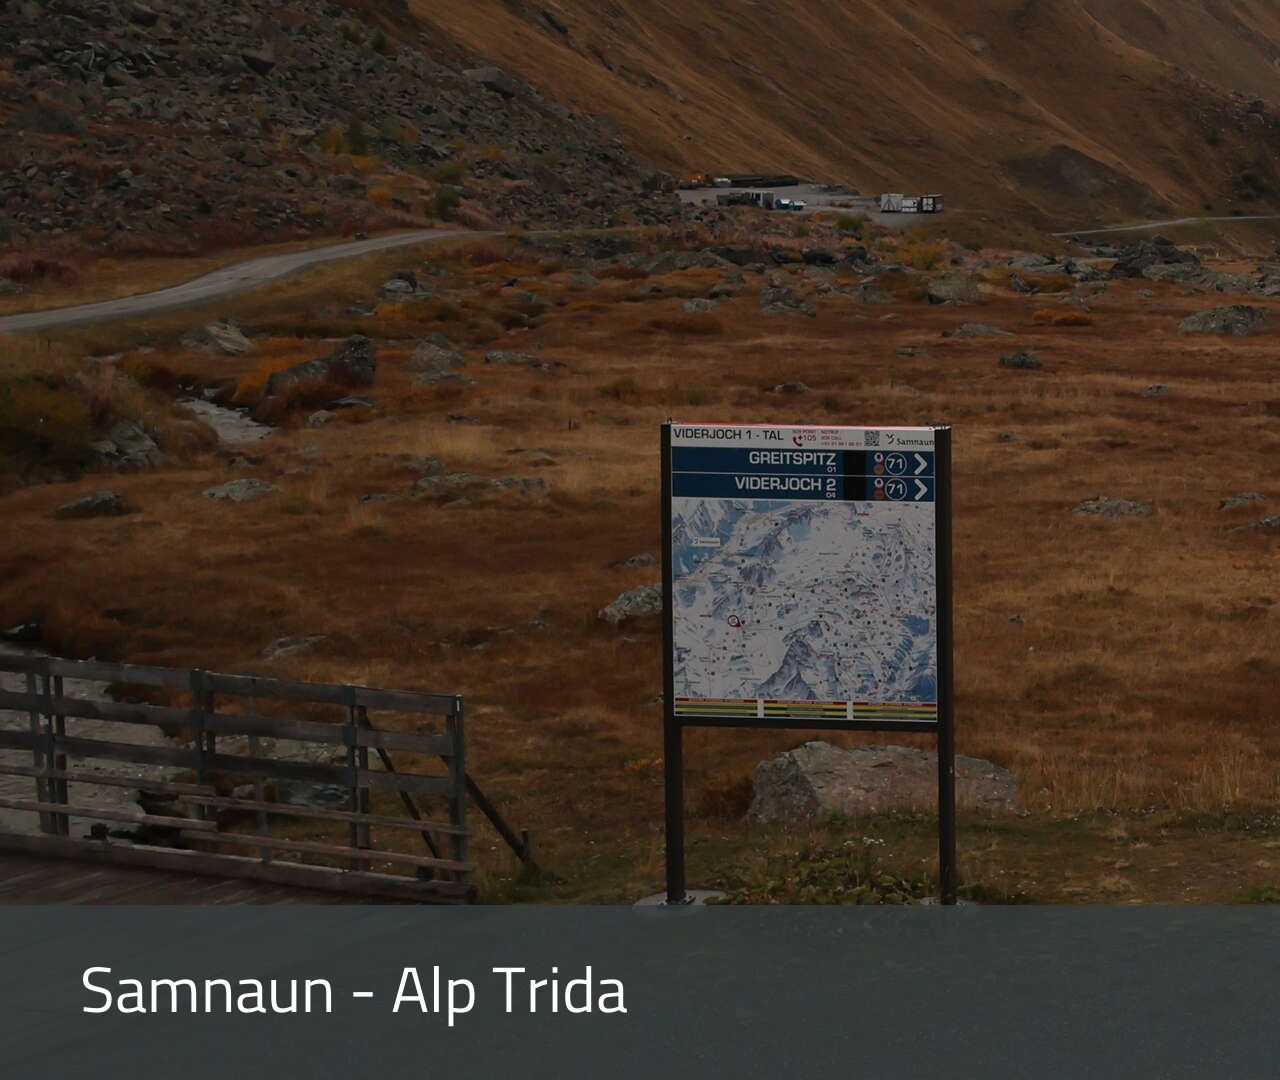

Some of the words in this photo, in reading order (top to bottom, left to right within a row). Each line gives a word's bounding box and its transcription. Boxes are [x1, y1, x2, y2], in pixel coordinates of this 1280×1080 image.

[673, 428, 742, 440] VIDERJOCH
[745, 430, 752, 440] 1
[763, 430, 784, 441] TAL
[896, 438, 935, 446] Samnaun
[749, 451, 837, 466] GREITSPITZ
[887, 458, 903, 469] 71
[735, 476, 822, 491] VIDERJOCH
[826, 477, 837, 491] 2
[887, 483, 903, 495] 71
